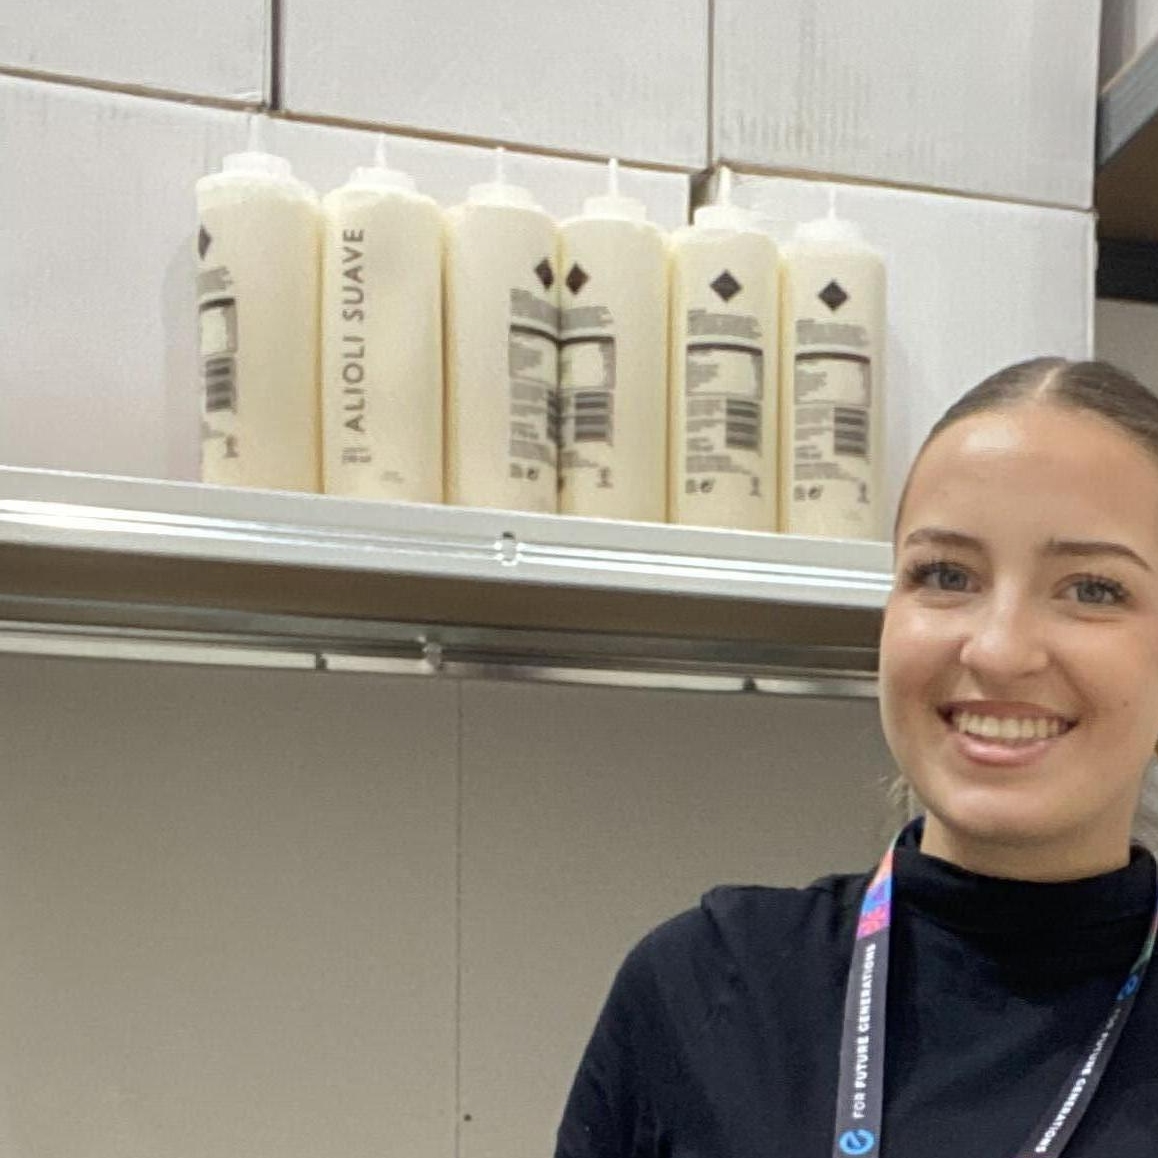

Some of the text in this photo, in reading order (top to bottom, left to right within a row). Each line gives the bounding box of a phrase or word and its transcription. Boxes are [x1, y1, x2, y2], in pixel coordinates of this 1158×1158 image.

[342, 229, 366, 323] SUAVE
[342, 336, 366, 433] ALIOLI
[852, 942, 877, 1119] FOR FUTURE GENERATIONS
[1034, 1077, 1087, 1153] GENERATIONS
